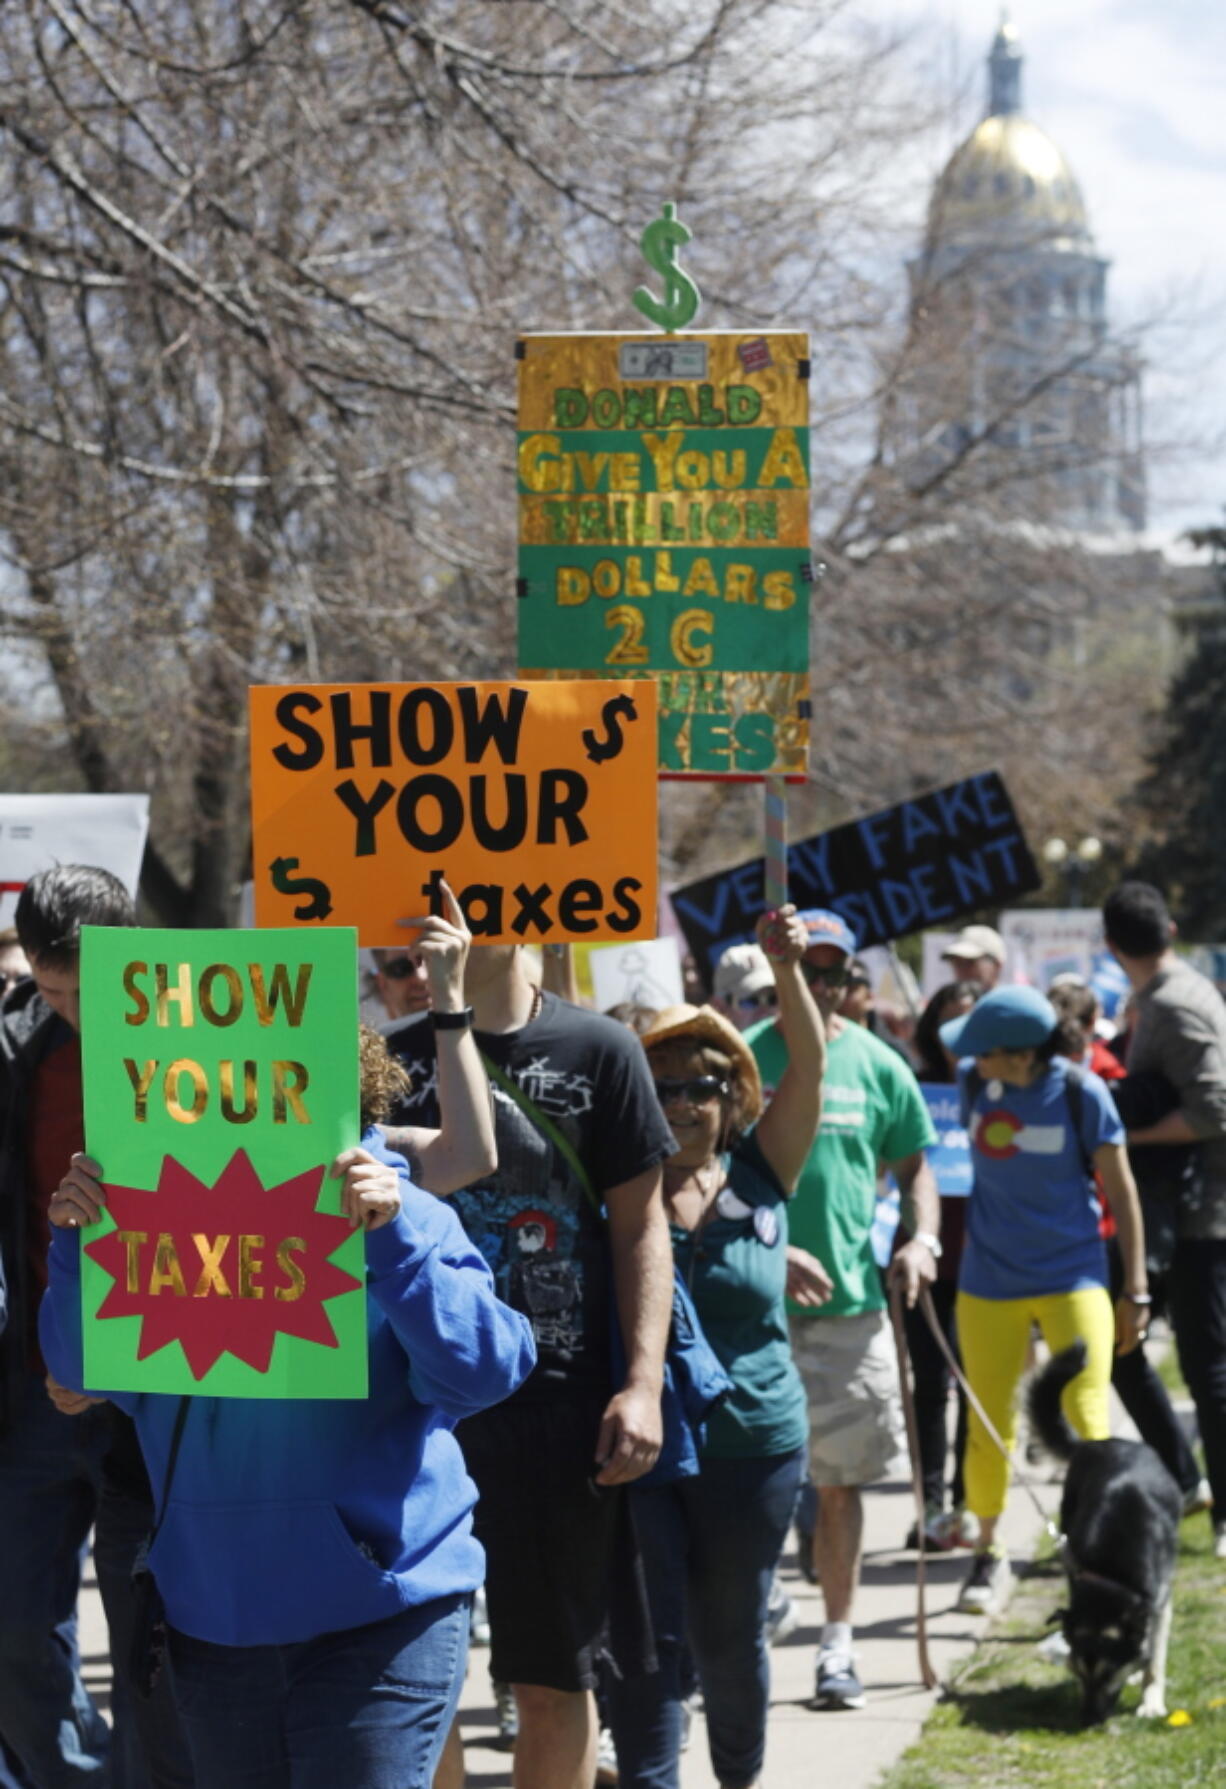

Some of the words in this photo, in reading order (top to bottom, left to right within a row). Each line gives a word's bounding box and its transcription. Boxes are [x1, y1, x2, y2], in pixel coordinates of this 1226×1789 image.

[554, 384, 762, 429] DONALD
[518, 433, 640, 492] GIVE
[642, 431, 746, 491] YOU
[757, 428, 809, 488] A
[542, 501, 777, 540] TRILLION
[556, 551, 796, 610] DOLLARS
[605, 604, 649, 665] 2
[670, 608, 715, 668] C
[272, 687, 529, 771] SHOW
[658, 713, 777, 770] XES
[334, 769, 589, 857] YOUR
[857, 772, 1011, 869] FAKE
[422, 870, 643, 936] taxes
[123, 961, 314, 1027] SHOW
[123, 1058, 313, 1124] YOUR
[117, 1231, 308, 1302] TAXES
